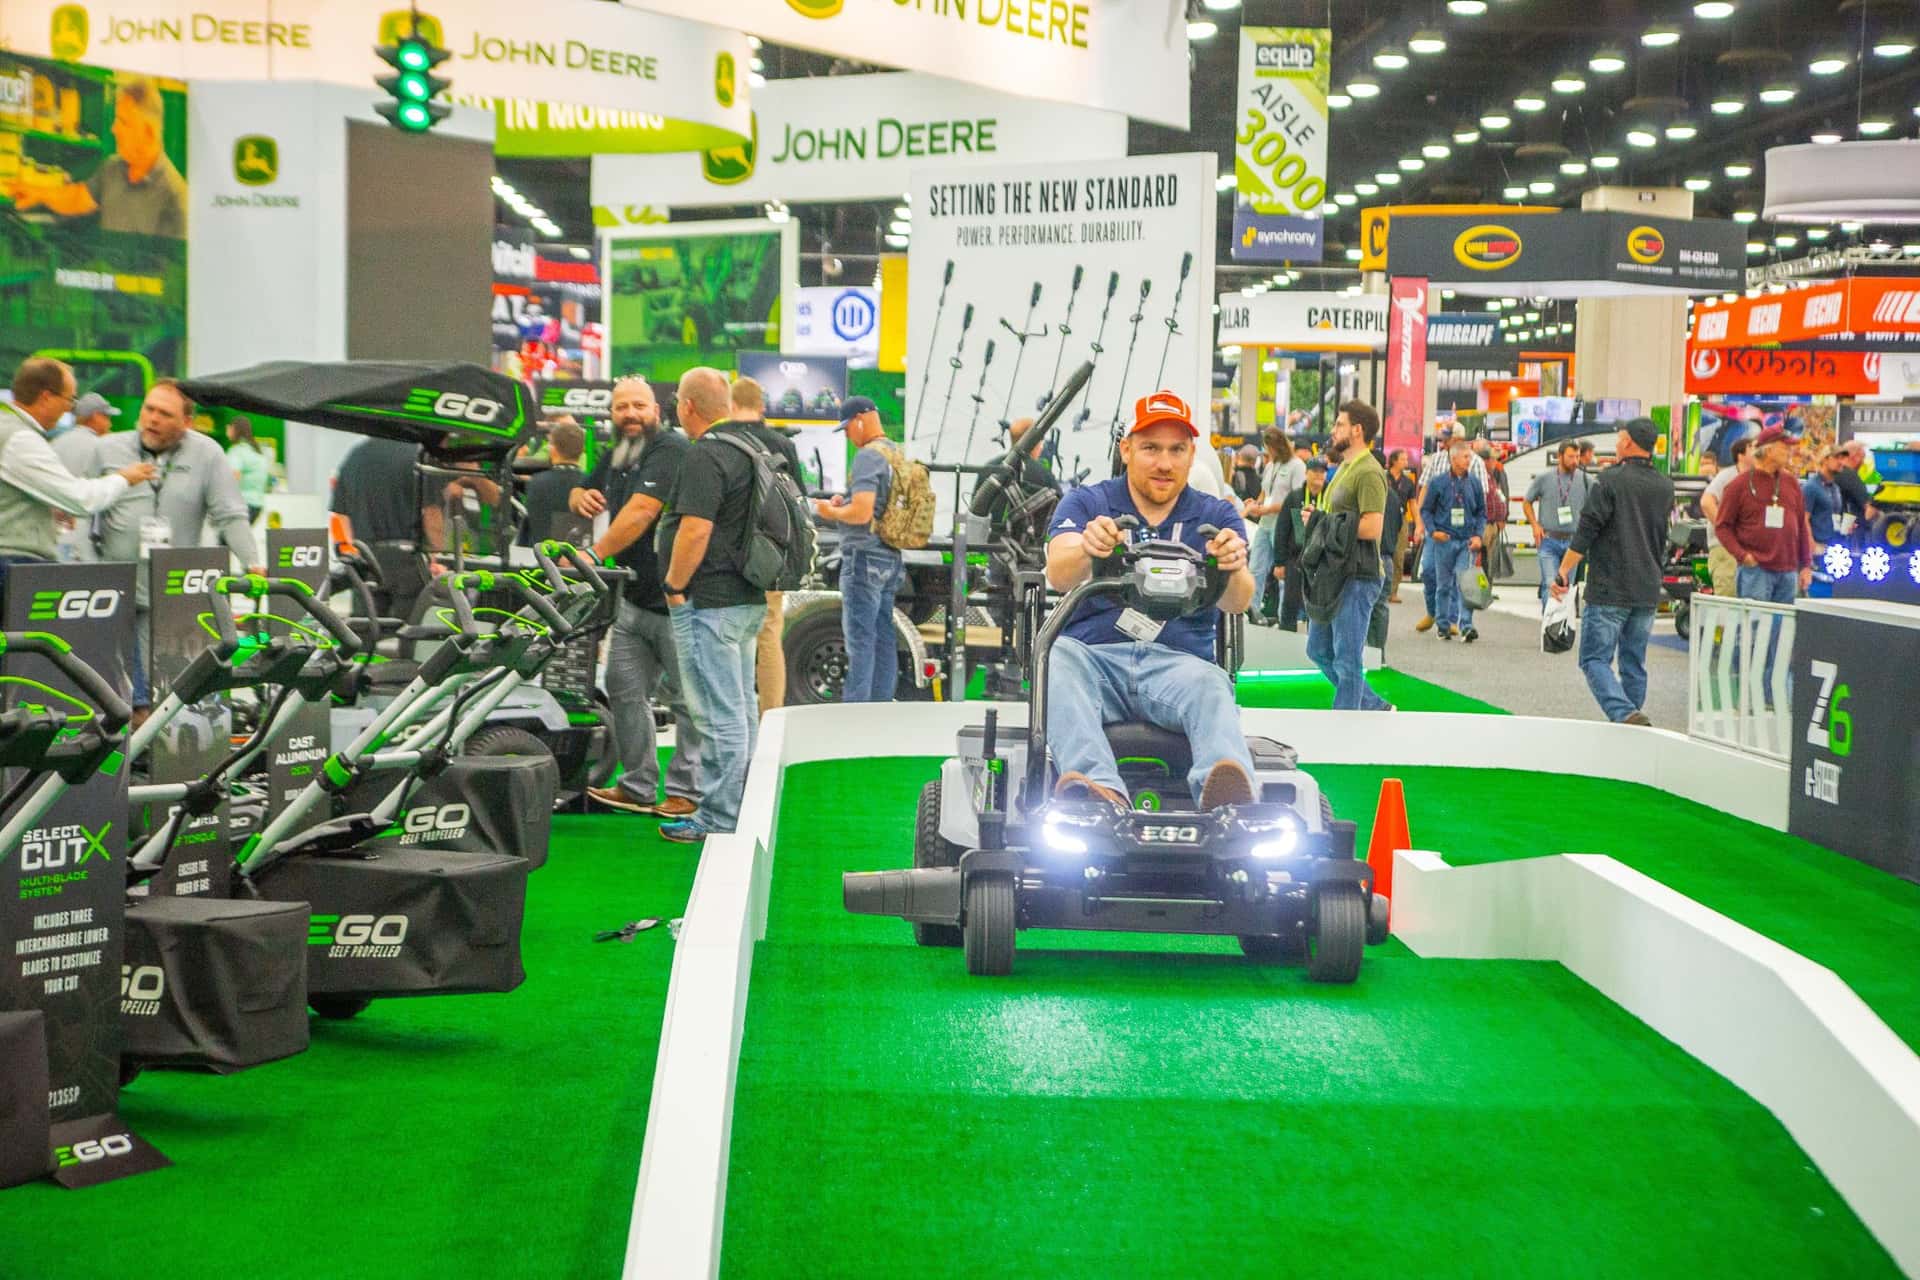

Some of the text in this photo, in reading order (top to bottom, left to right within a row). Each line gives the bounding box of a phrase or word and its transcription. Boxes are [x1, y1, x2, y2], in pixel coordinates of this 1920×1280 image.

[101, 14, 311, 48] JOHN DEERE
[461, 32, 657, 80] JOHN DEERE
[1258, 45, 1313, 69] equip
[504, 98, 538, 130] IN
[1252, 83, 1315, 146] AISLE
[772, 118, 997, 162] JOHN DEERE
[1236, 108, 1326, 211] 3000
[930, 174, 1178, 216] SETTING THE NEW STANDARD
[957, 220, 1146, 247] POWER. PERFORMANCE. DURABILITY.
[1257, 229, 1316, 246] synchrony
[402, 388, 499, 423] EGO
[543, 388, 612, 407] EGO
[278, 546, 322, 568] EGO
[164, 569, 219, 595] EGO
[28, 589, 120, 620] EGO
[289, 735, 316, 750] CAST
[275, 747, 327, 766] ALUMINUM
[22, 824, 81, 843] SELECT
[399, 828, 466, 845] SELF PROPELLED
[1141, 826, 1198, 842] EGO
[18, 870, 88, 887] MULTI-BLADE
[19, 885, 62, 899] SYSTEM
[33, 911, 70, 930] INCLUDES
[307, 914, 408, 945] EGO
[328, 945, 402, 958] SELF PROPELLED
[54, 1133, 133, 1168] EGO
